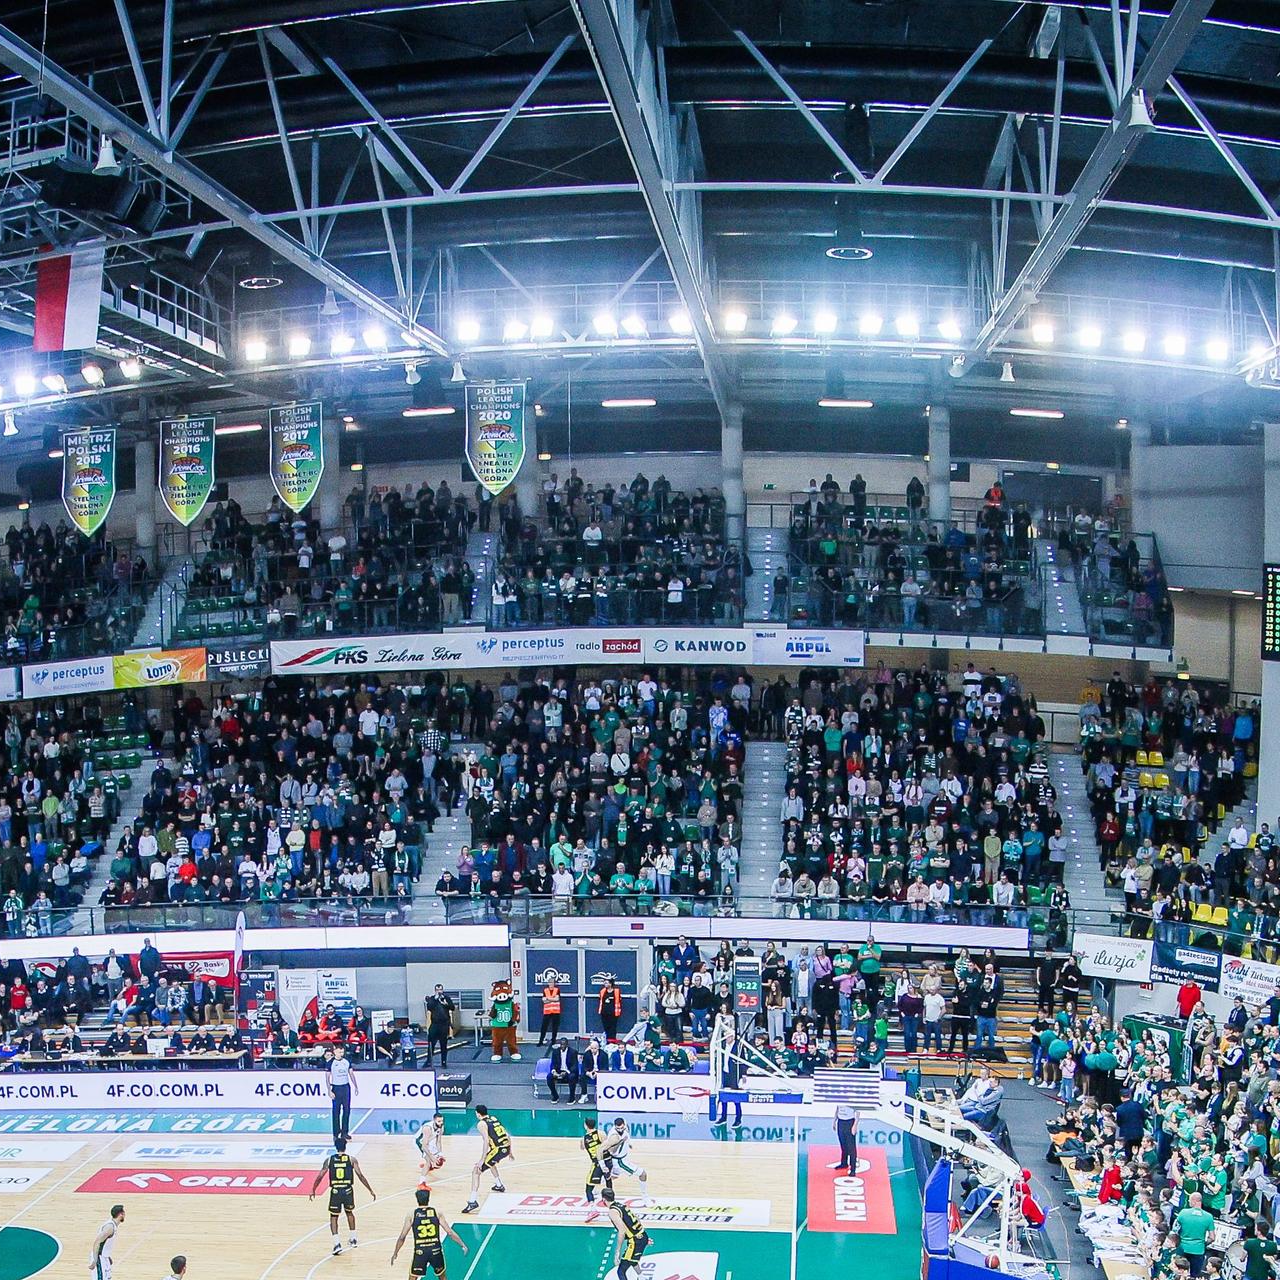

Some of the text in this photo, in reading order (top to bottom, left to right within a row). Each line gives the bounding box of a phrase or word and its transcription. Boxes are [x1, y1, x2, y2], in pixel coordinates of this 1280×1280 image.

[478, 395, 512, 403] LEAGUE
[280, 406, 312, 417] POLISH
[470, 402, 520, 410] CHAMPIONS
[281, 415, 310, 424] LEAGUE
[479, 411, 511, 420] 2020
[171, 421, 205, 430] POLISH
[274, 422, 318, 432] CHAMPIONS
[67, 433, 112, 446] MISTRZ
[164, 437, 210, 445] CHAMPIONS
[283, 430, 309, 442] 2017
[67, 444, 111, 457] POLSKI
[173, 445, 200, 455] 2016
[76, 455, 101, 466] 2015
[502, 638, 565, 650] perceptus
[576, 641, 639, 651] radio zachód
[675, 640, 747, 652] KANWOD
[785, 642, 832, 653] ARPOL
[335, 646, 462, 664] PKS Zielona Góra
[52, 664, 105, 682] perceptus
[146, 664, 172, 680] LOTTO
[1093, 950, 1136, 973] iluzja
[736, 982, 757, 990] 9:22
[738, 993, 758, 1008] 2,5
[380, 1083, 432, 1097] 4F.CO
[598, 1086, 675, 1100] .COM.PL
[170, 1117, 295, 1132] GÓRA
[336, 1168, 344, 1179] 0
[179, 1175, 304, 1188] ORLEN
[834, 1176, 867, 1221] ORLEN
[417, 1224, 436, 1237] 33
